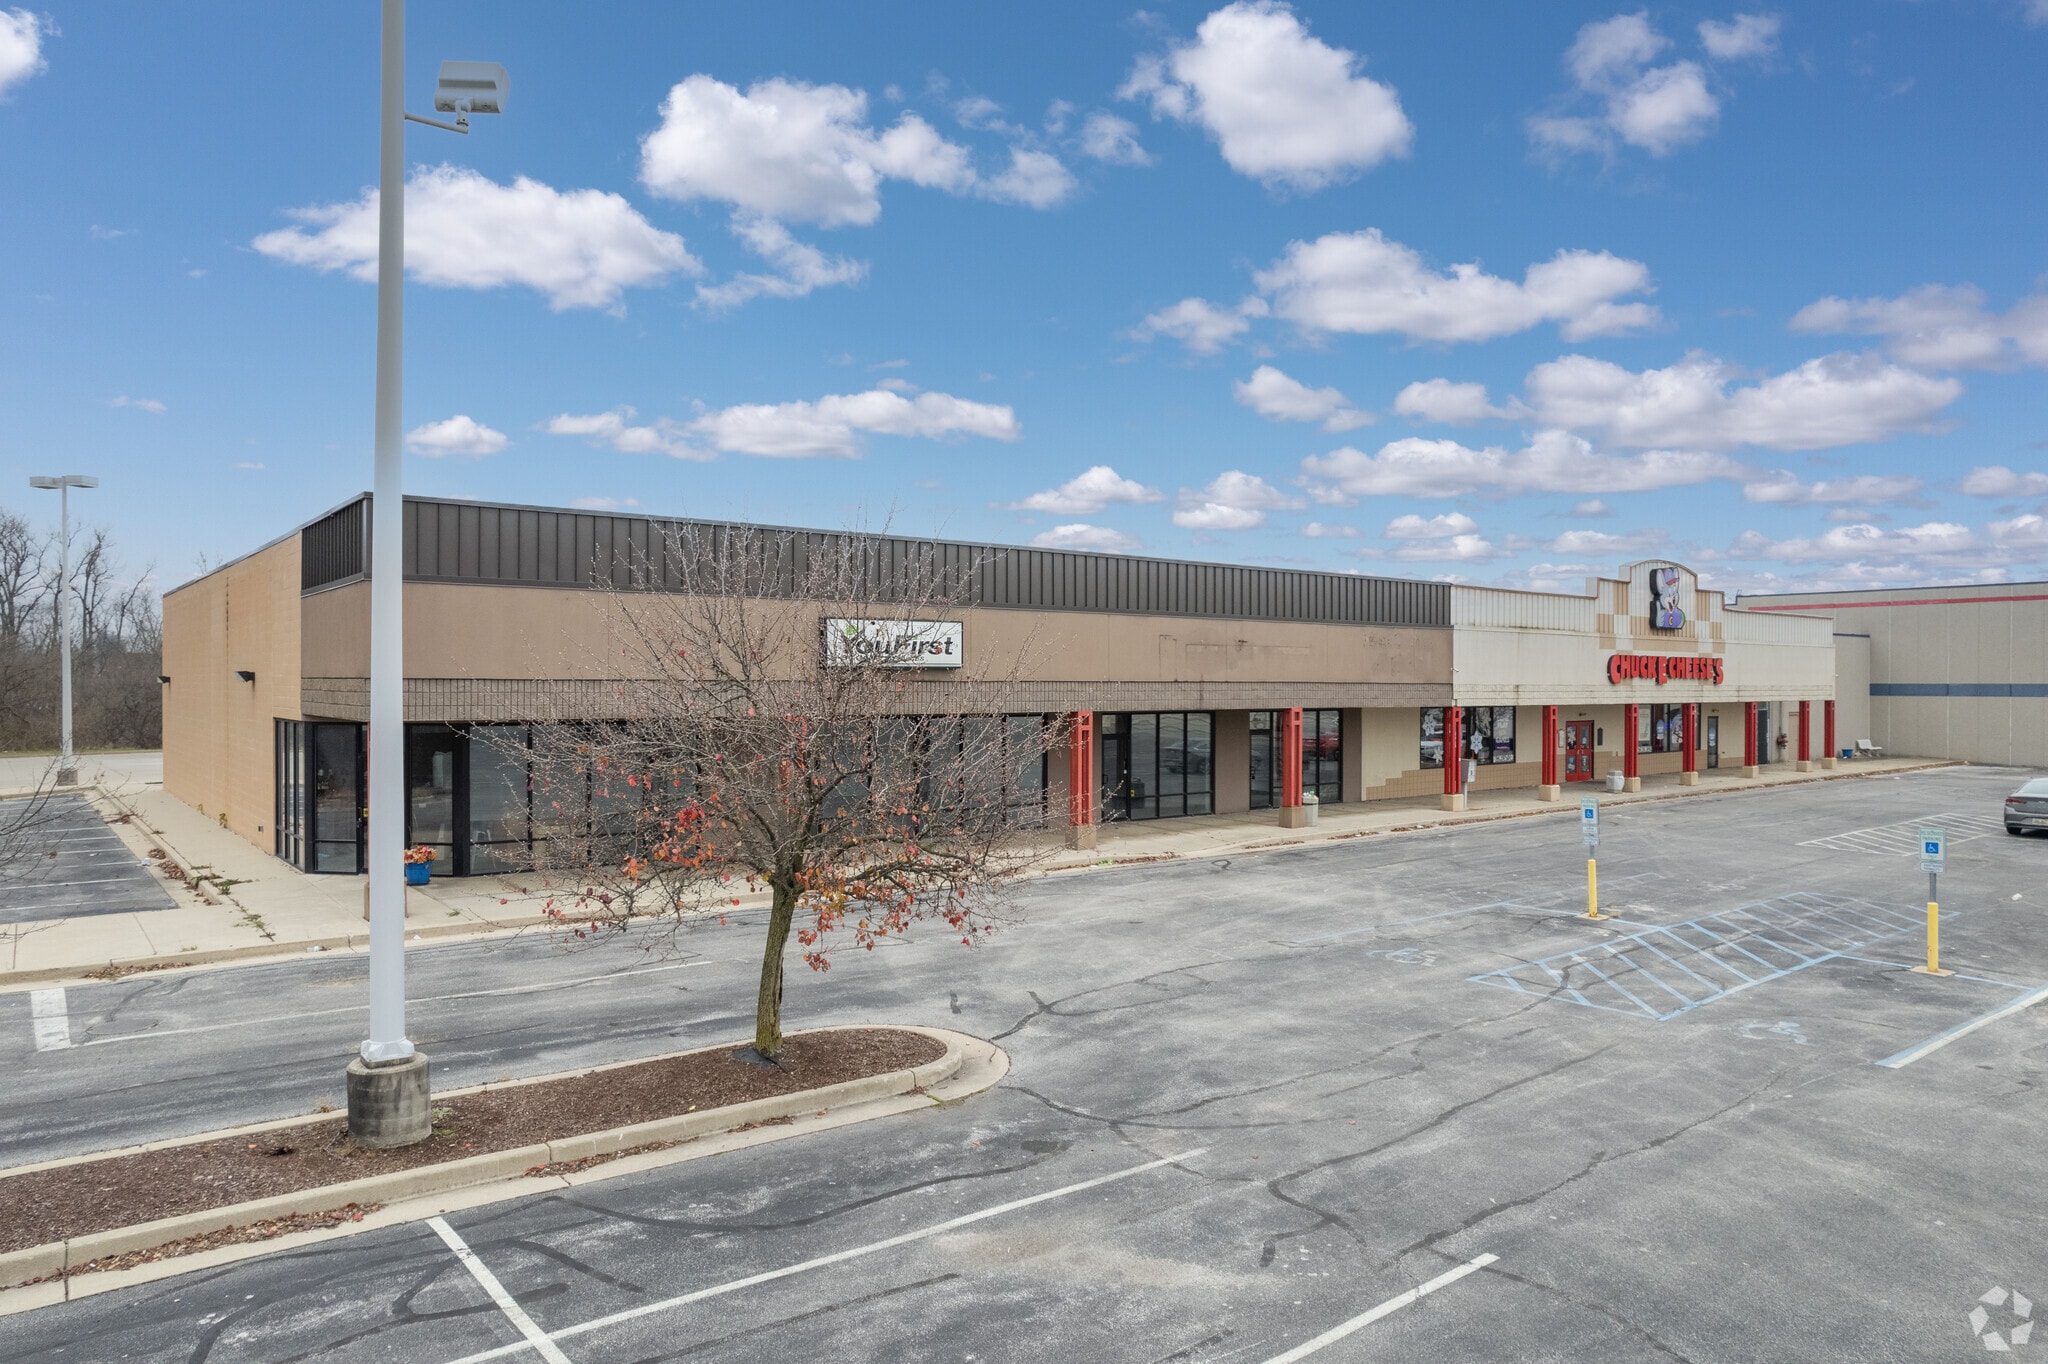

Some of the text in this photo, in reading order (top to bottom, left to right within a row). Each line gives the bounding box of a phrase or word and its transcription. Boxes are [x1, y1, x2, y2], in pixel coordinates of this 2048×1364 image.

[1608, 654, 1724, 685] CHUCK E CHEESE'S
